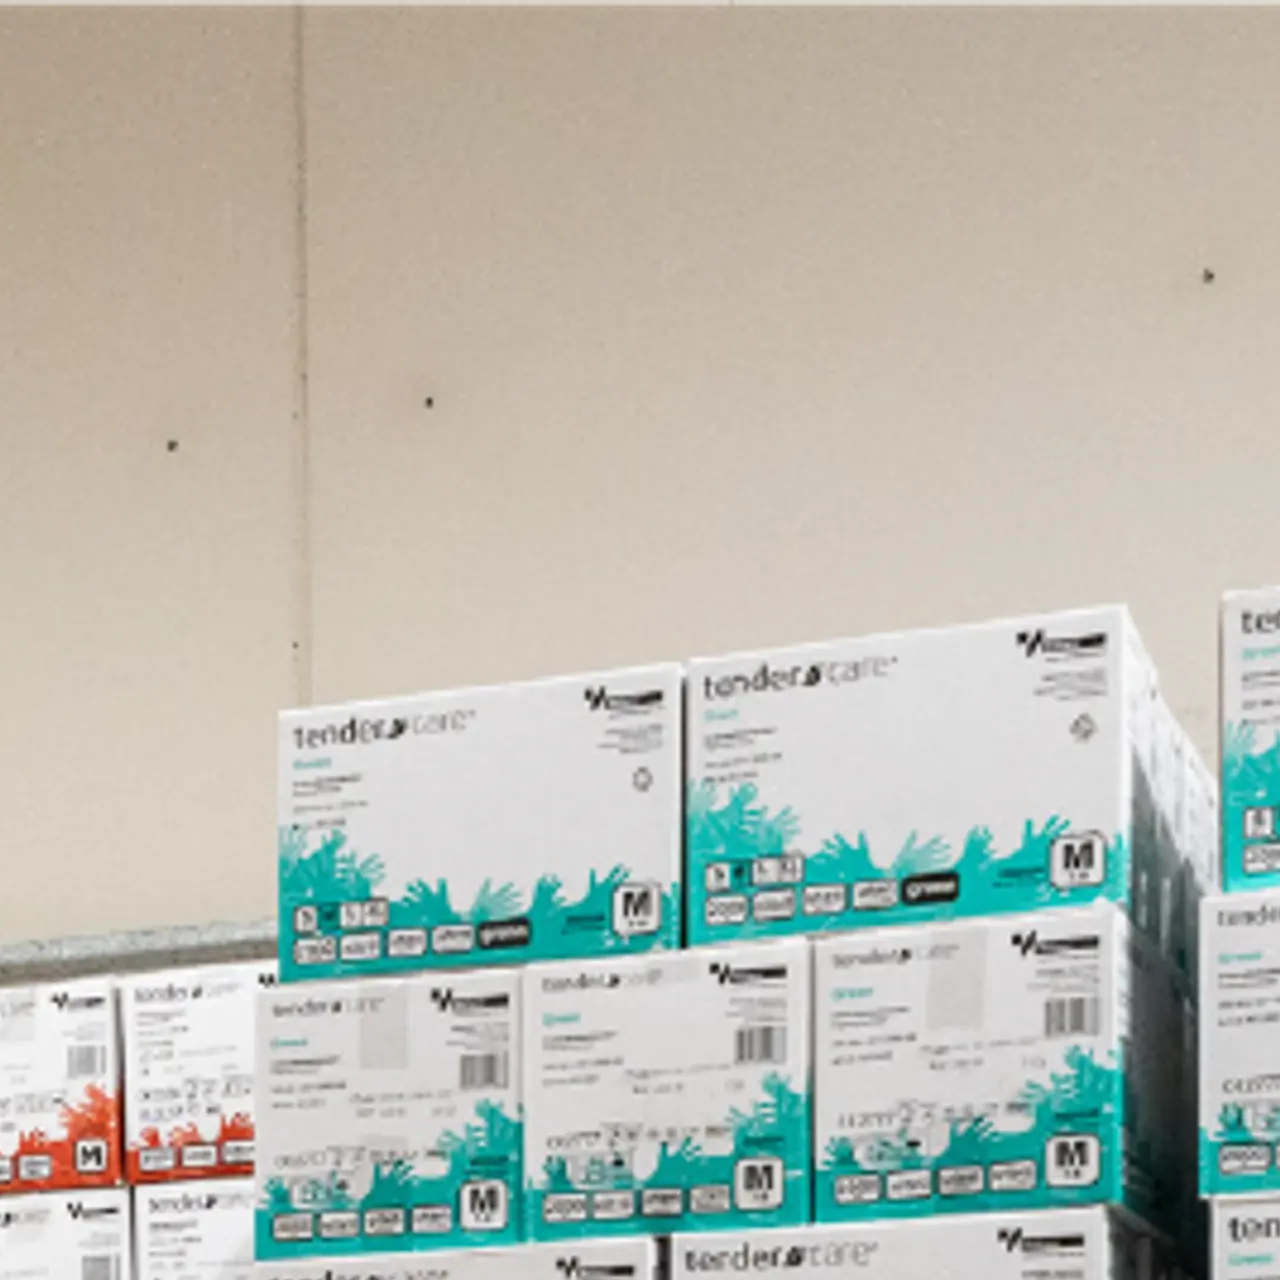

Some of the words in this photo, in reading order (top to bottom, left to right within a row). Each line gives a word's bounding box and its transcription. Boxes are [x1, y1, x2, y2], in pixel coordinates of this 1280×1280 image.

[1064, 841, 1094, 869] M
[623, 890, 650, 917] M
[1057, 1141, 1087, 1166] M
